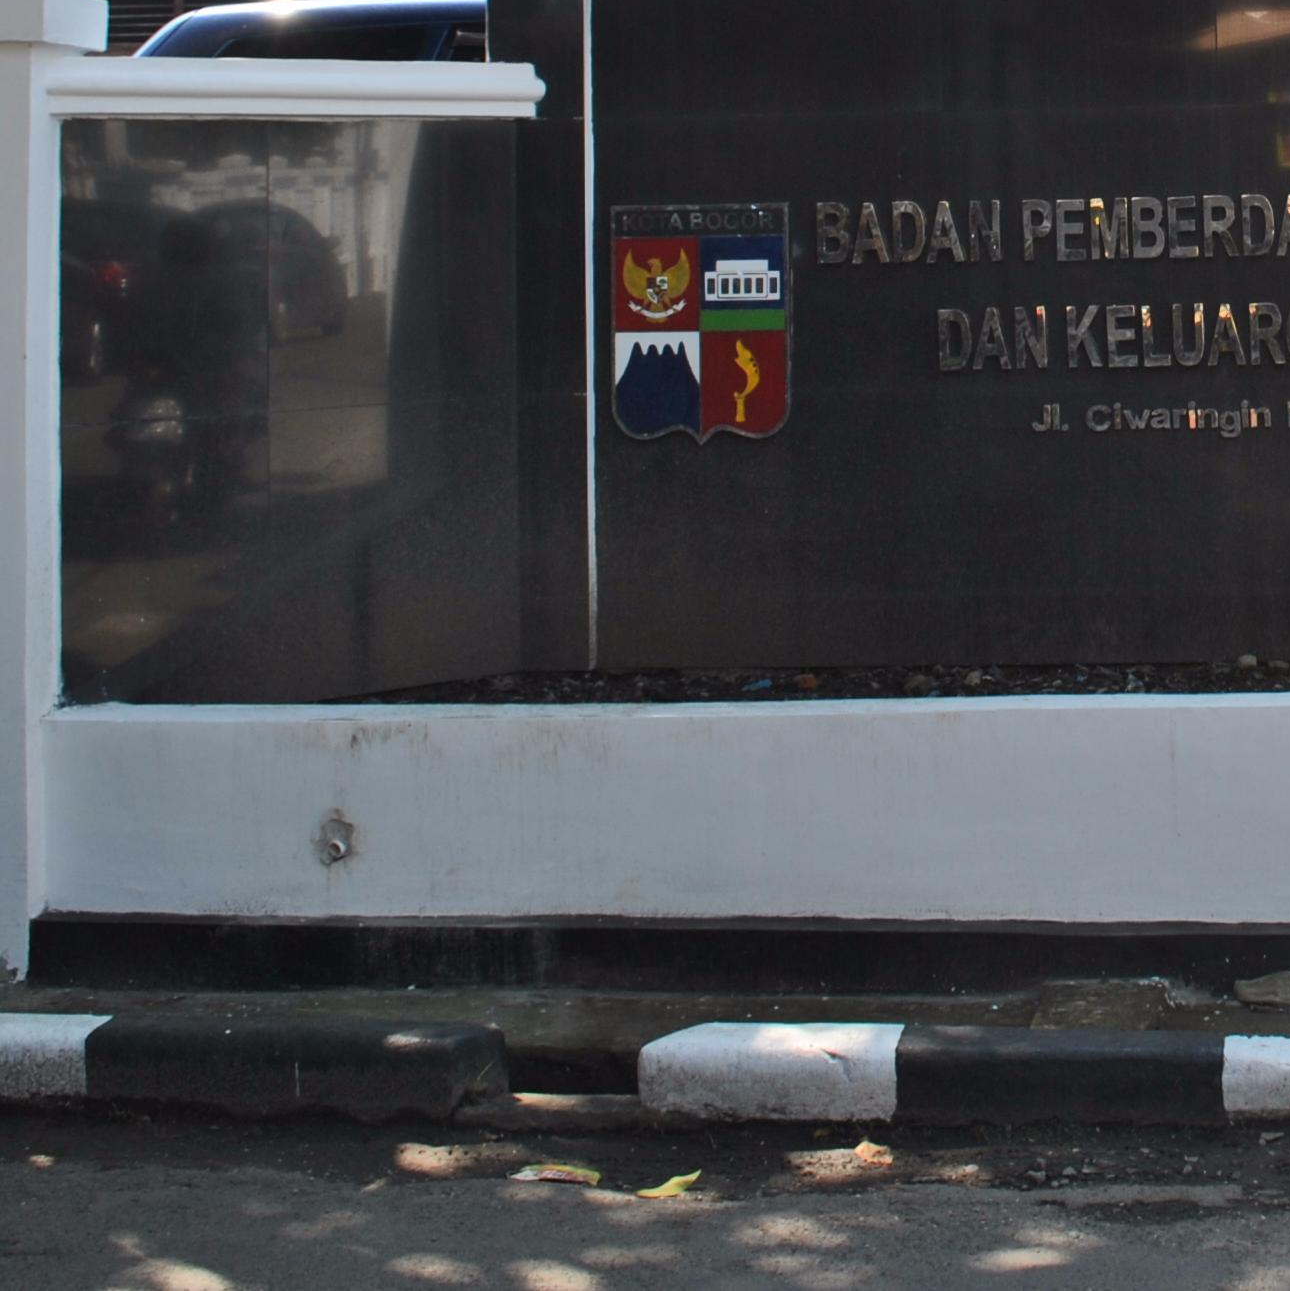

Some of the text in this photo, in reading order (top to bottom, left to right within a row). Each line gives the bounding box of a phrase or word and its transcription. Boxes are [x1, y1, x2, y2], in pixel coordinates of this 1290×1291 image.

[622, 211, 775, 232] KOTA BOGOR
[815, 200, 1002, 264] BADAN
[937, 305, 1048, 372] DAN
[1032, 404, 1069, 432] Jl.
[1085, 399, 1272, 438] Ciwaringin
